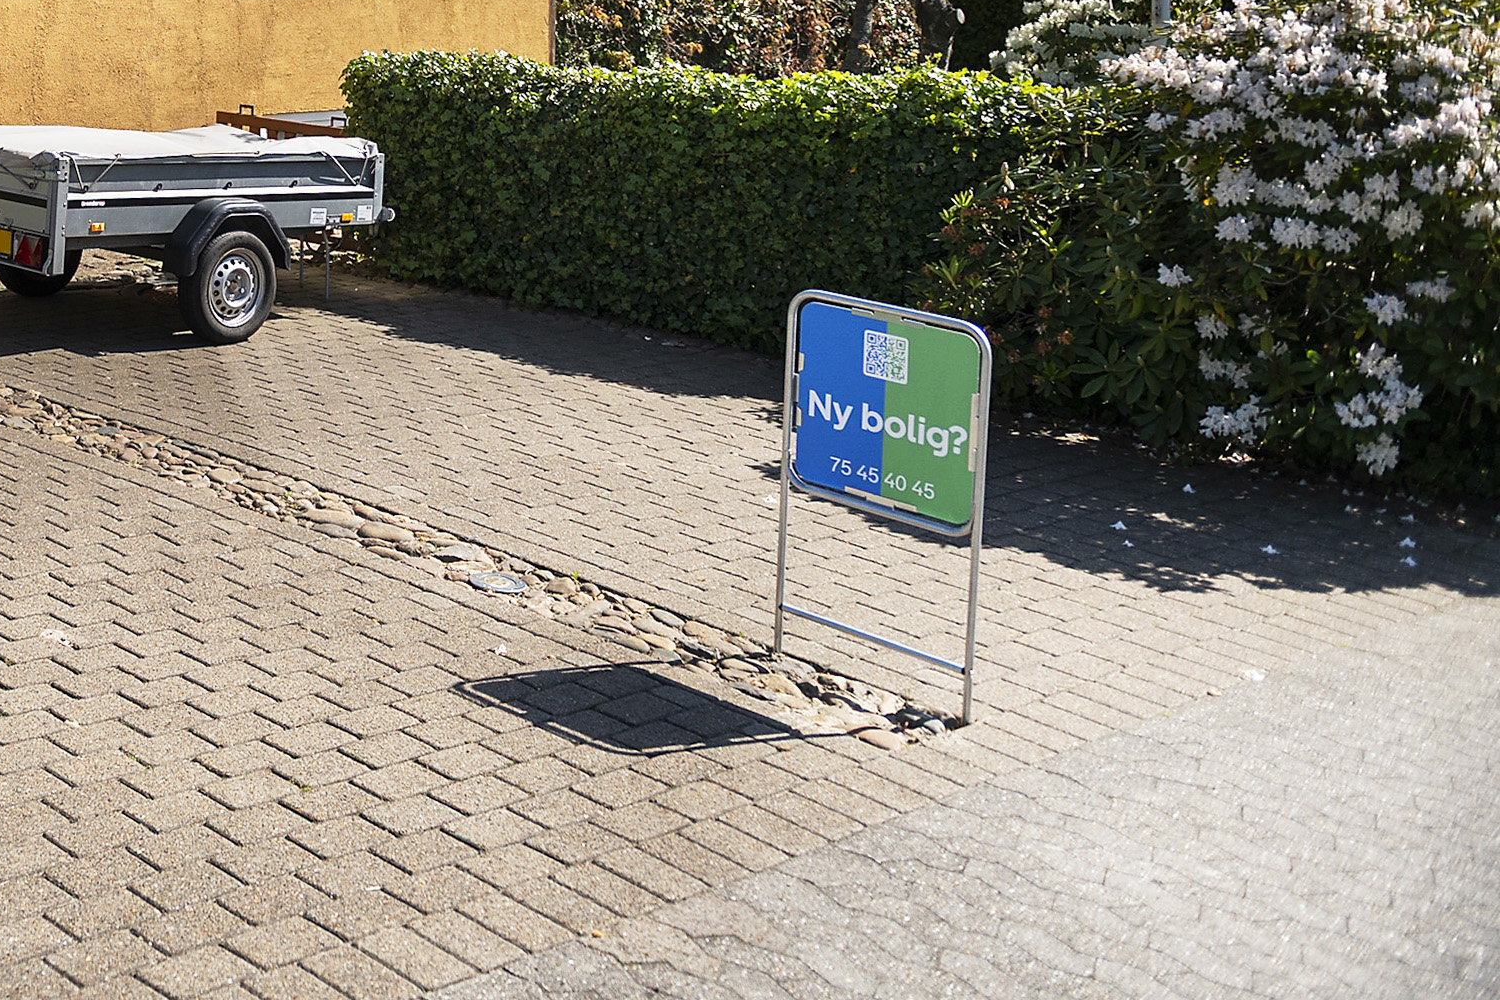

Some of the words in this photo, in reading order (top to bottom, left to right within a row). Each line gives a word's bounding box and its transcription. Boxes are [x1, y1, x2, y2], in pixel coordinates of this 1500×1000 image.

[808, 389, 854, 431] Ny
[861, 402, 968, 458] bolig?
[829, 456, 852, 476] 75
[856, 464, 880, 484] 45
[884, 472, 907, 492] 40
[911, 480, 935, 500] 45
